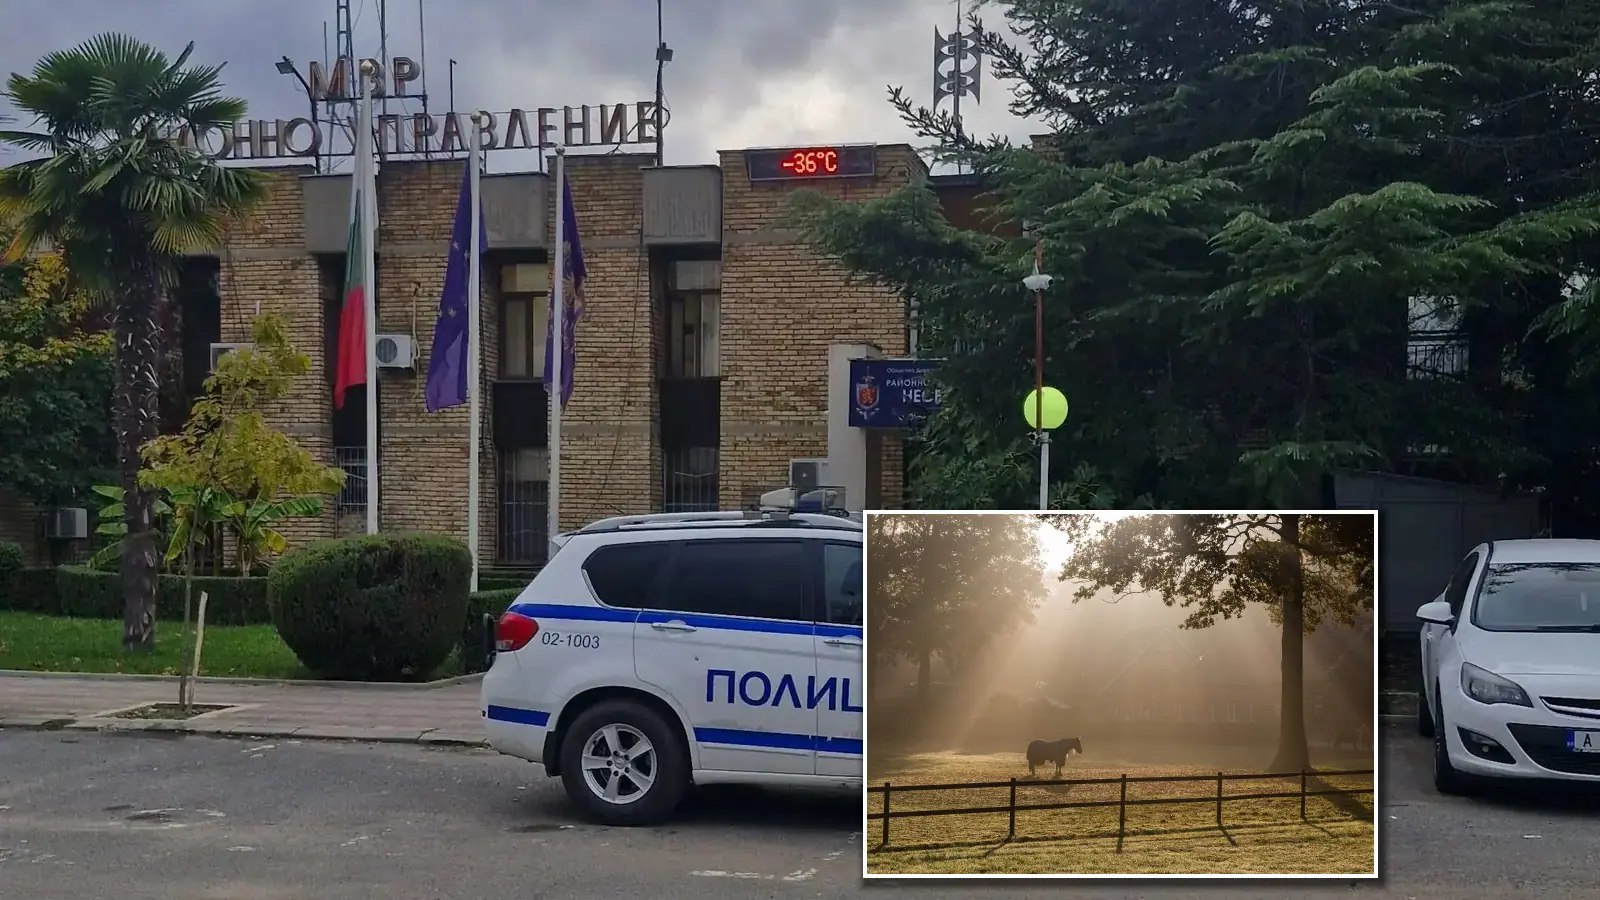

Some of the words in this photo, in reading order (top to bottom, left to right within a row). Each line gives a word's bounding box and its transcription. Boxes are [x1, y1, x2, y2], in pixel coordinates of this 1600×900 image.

[310, 57, 420, 100] МВР
[176, 117, 323, 160] ОННО
[783, 151, 837, 173] -36°C
[902, 389, 942, 405] НЕСЕ
[541, 631, 600, 649] 02-1003
